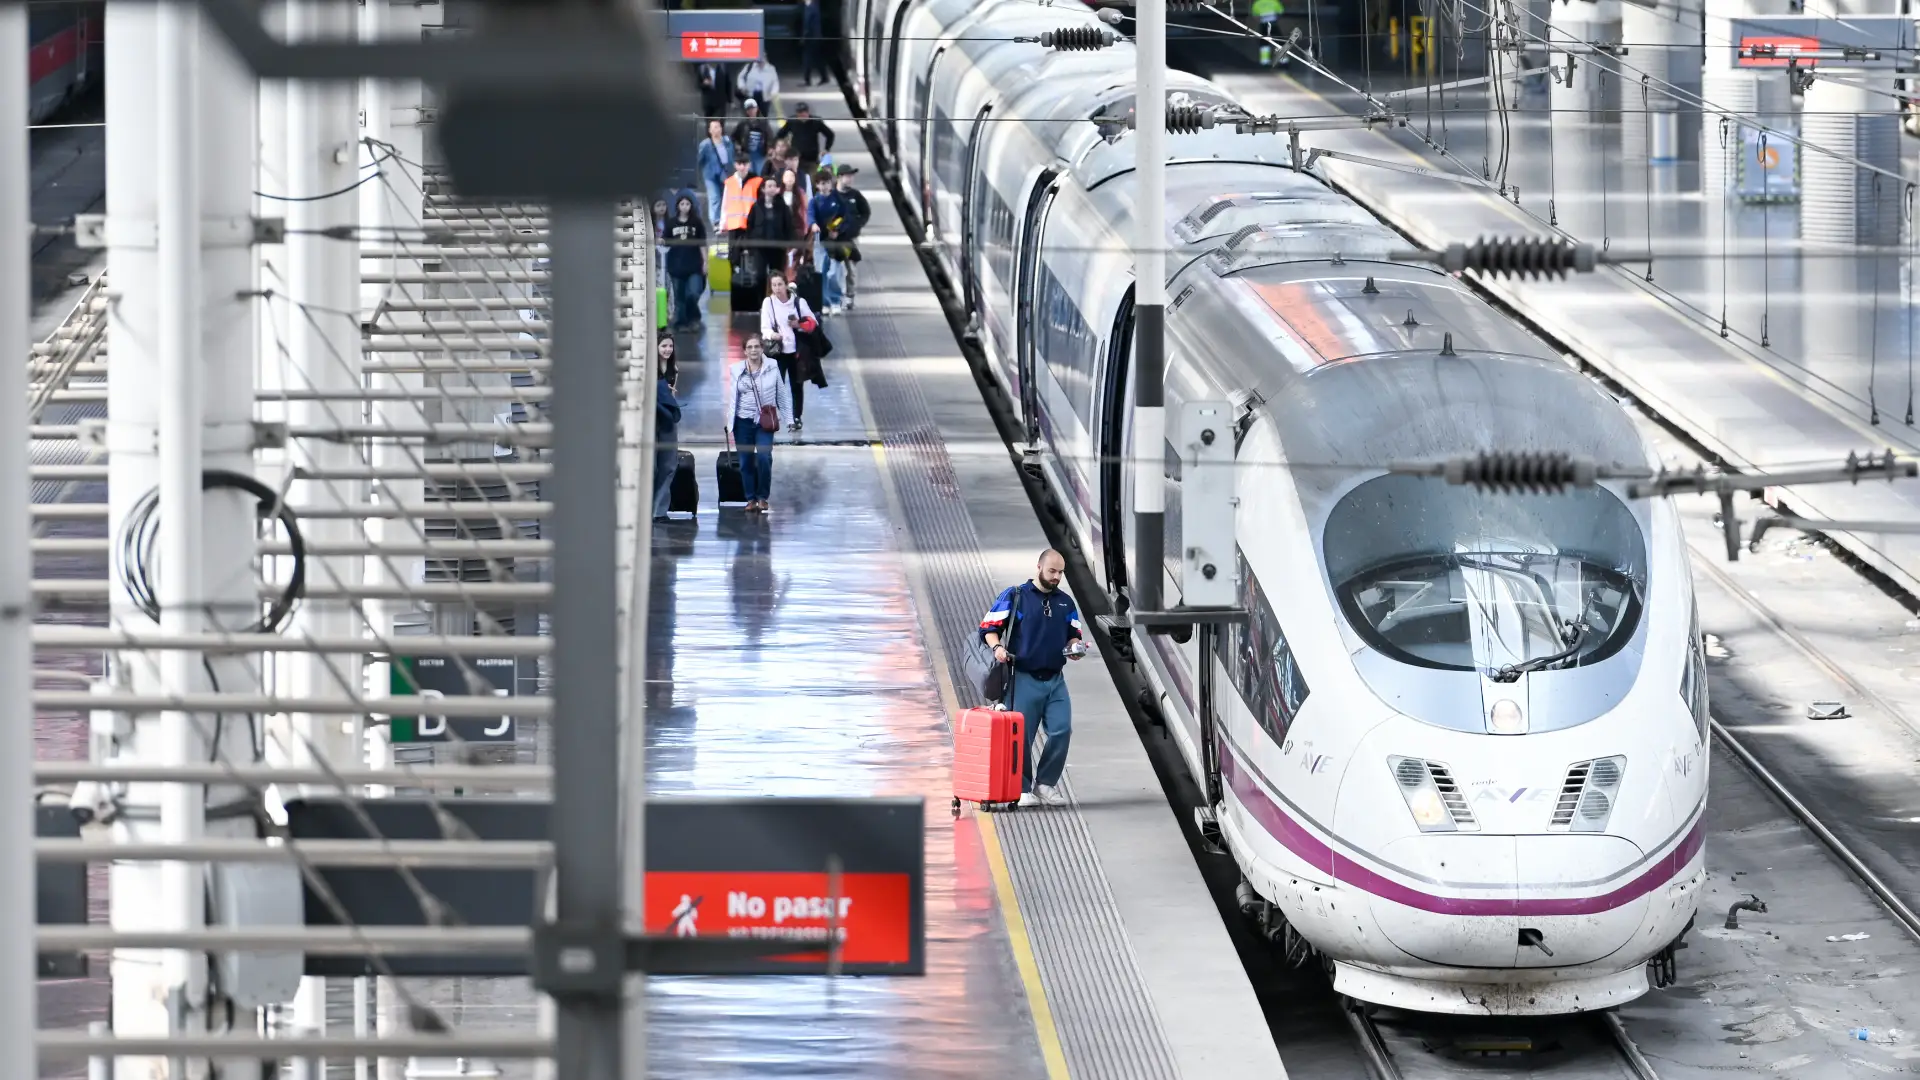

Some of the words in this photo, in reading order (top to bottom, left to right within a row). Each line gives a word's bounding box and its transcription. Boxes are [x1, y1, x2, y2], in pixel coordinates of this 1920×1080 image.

[418, 659, 444, 667] SECTOR
[476, 659, 513, 667] PLATFORM
[1299, 751, 1333, 776] AVE
[1473, 787, 1558, 804] AVE
[727, 891, 766, 918] No
[773, 896, 852, 924] pasar
